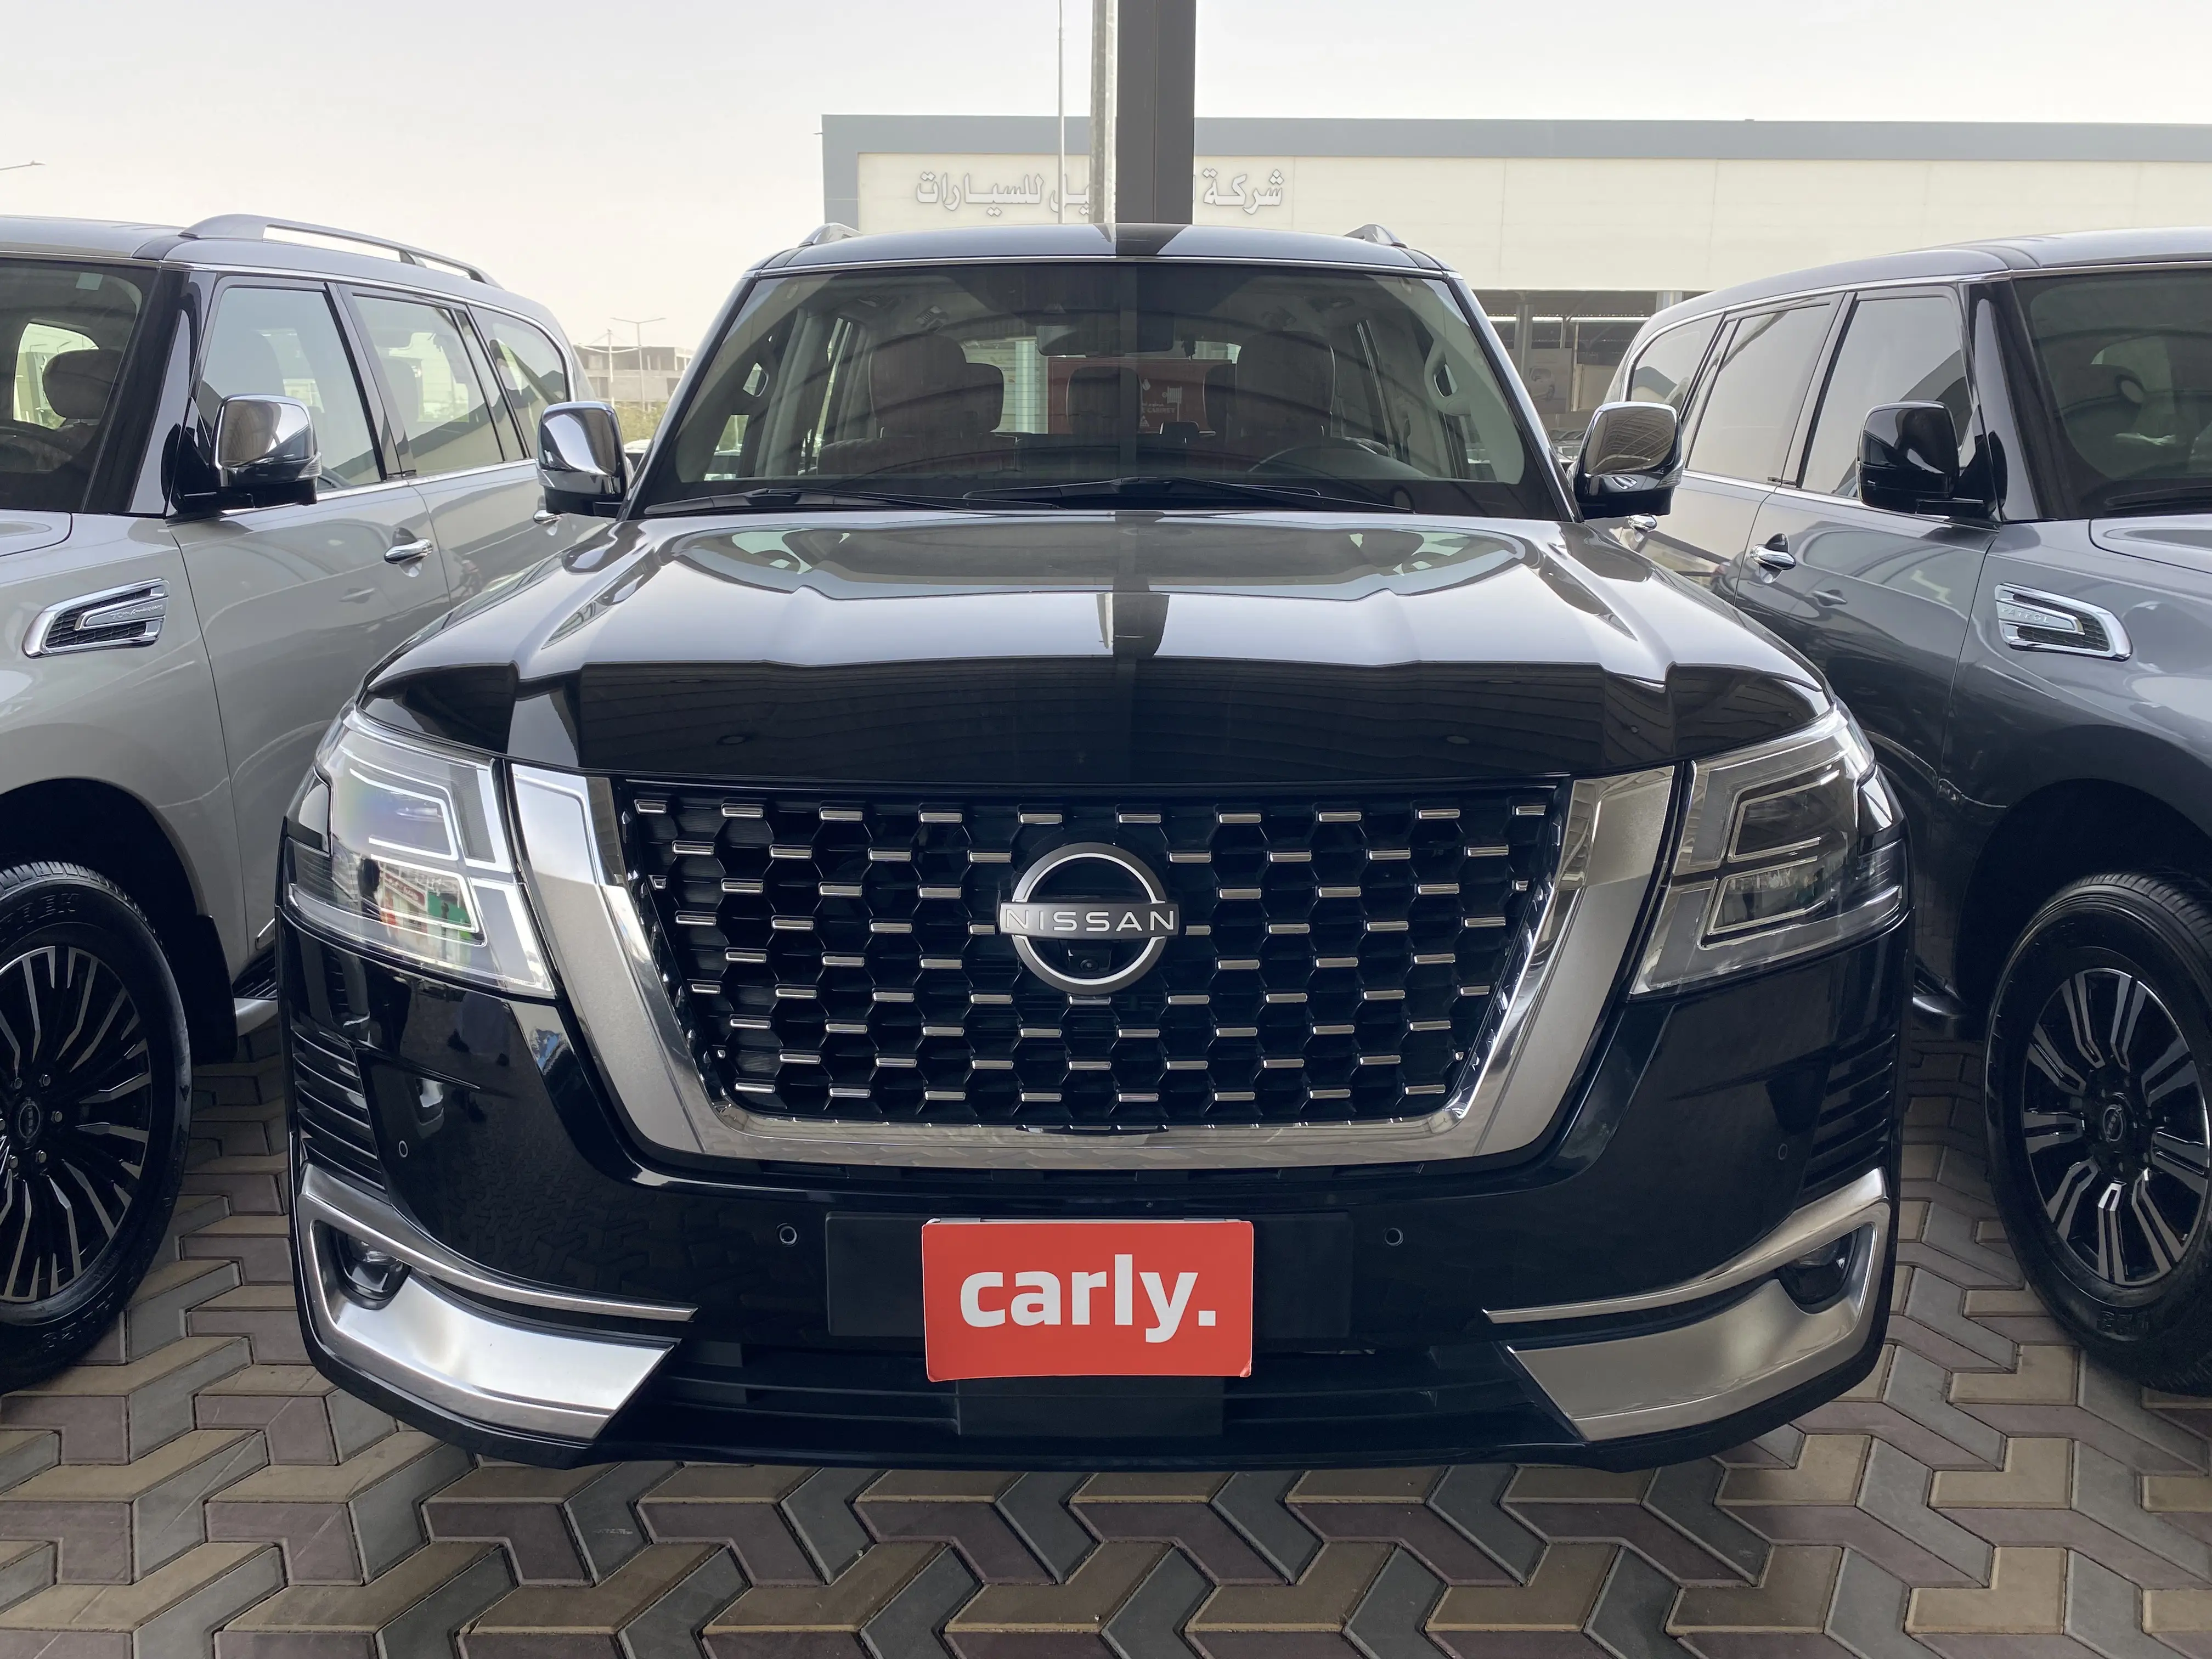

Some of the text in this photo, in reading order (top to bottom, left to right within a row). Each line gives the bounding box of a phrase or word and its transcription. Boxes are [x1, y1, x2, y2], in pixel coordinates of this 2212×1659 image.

[917, 171, 1044, 216] للسيارات
[1202, 168, 1284, 215] شركة
[2001, 607, 2050, 624] PATROL
[1005, 909, 1174, 932] NISSAN
[960, 1254, 1216, 1342] carly.
